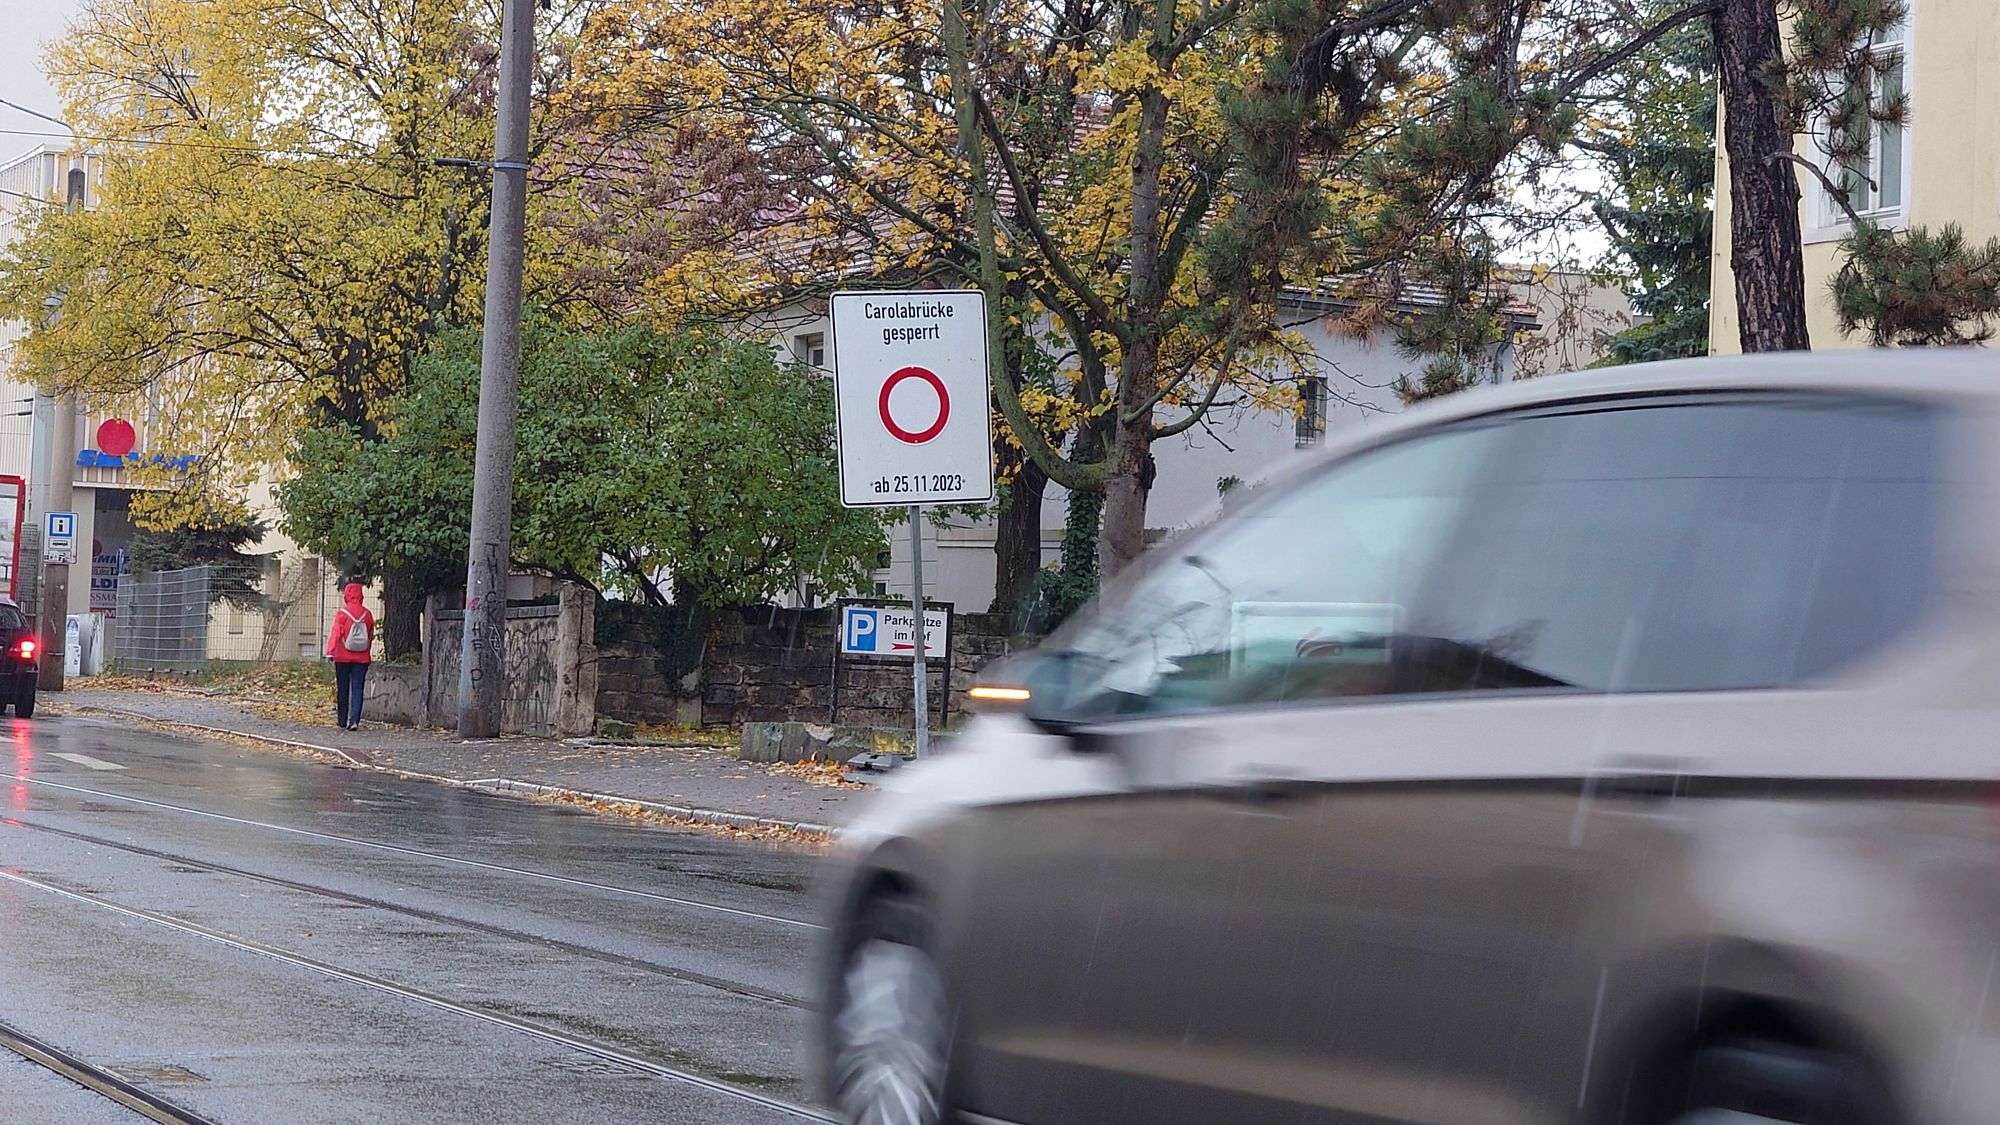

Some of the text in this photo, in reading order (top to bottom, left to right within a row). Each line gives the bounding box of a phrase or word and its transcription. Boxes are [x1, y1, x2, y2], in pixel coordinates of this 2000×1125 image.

[865, 301, 954, 319] Carolabrücke
[883, 324, 940, 345] gesperrt
[874, 474, 962, 493] ab 25.11.2023
[91, 578, 117, 588] LDI
[90, 593, 117, 601] SSMA
[884, 614, 942, 628] Parkptze
[894, 630, 908, 640] im
